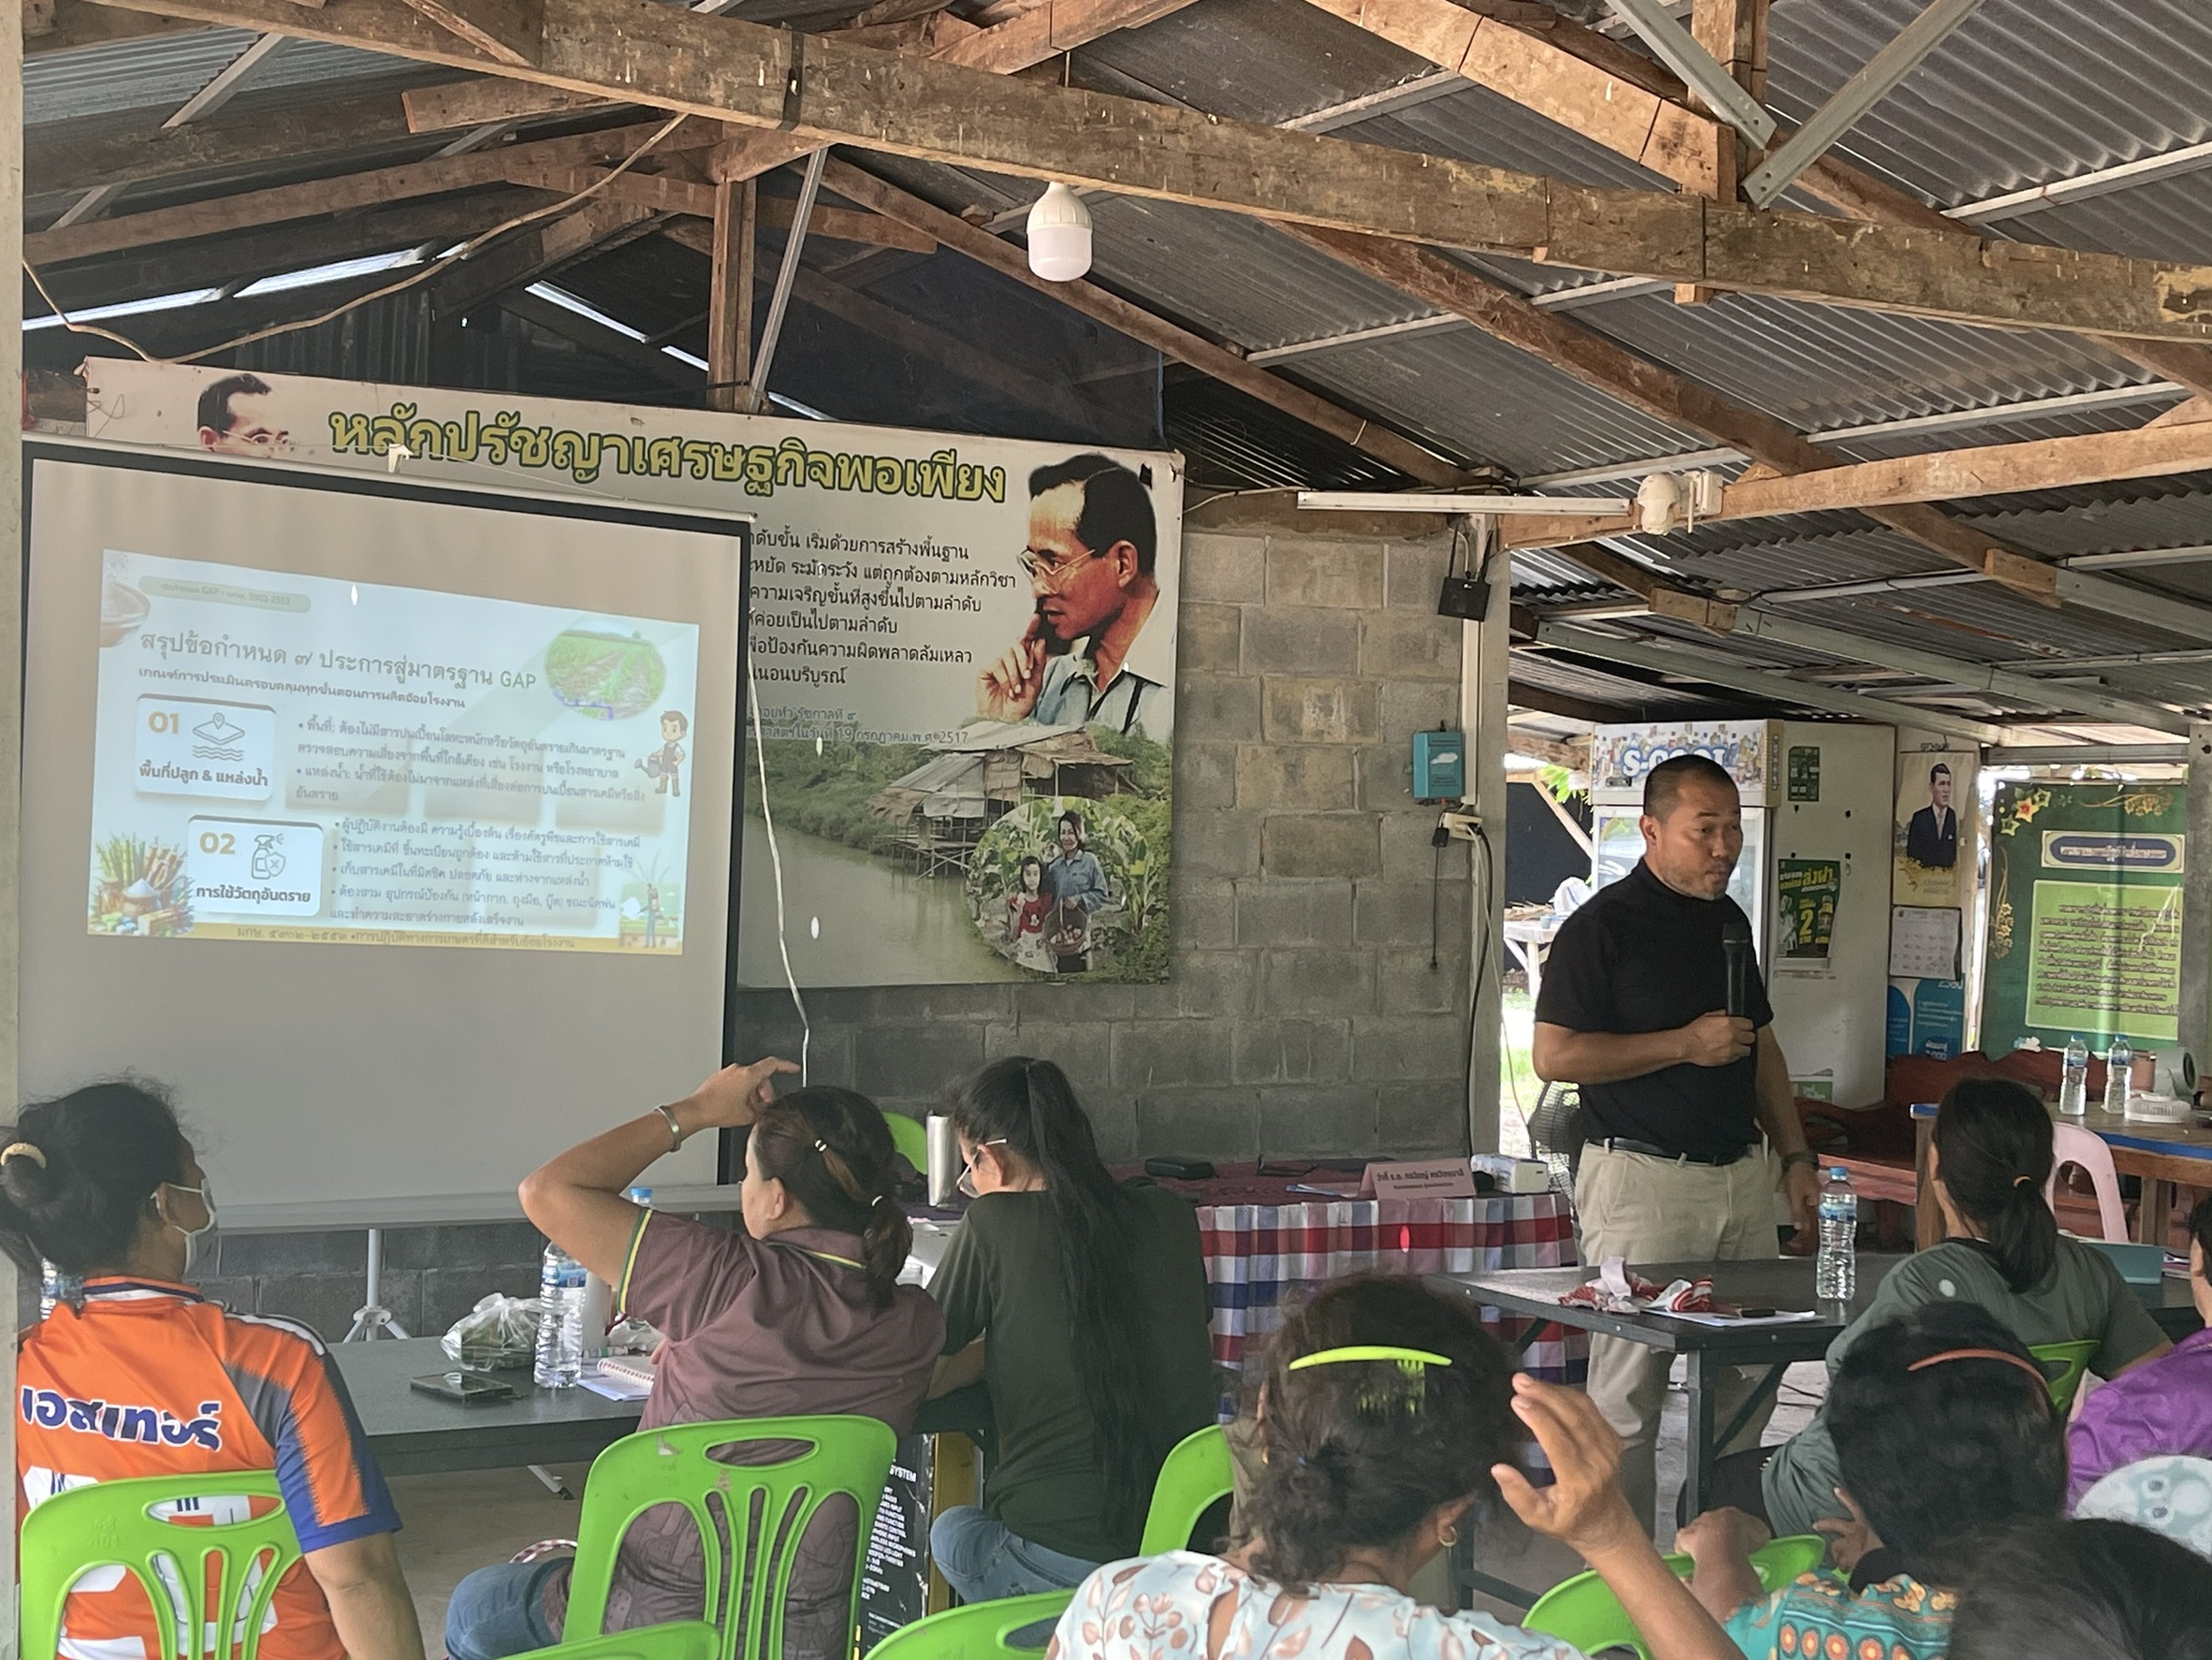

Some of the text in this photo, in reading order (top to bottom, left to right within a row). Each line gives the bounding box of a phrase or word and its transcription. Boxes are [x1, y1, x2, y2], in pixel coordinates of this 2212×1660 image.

[328, 402, 1008, 503] หลักปรัชญาเศรษฐกิจพอเพียง
[806, 528, 969, 563] เริ่มด้วยการสร้างพื้นฐาน
[864, 561, 1017, 590] แต่ถูกต้องตามหลักวิชา
[201, 586, 220, 596] GAP
[749, 582, 982, 613] ความเจริญขั้นที่สูงขึ้นไปตามลำดับ
[141, 629, 536, 690] สรุปข้อกำหนด ๗ ประการสู่มาตรฐาน GAP
[148, 709, 179, 735] 01
[837, 727, 852, 739] 19
[939, 731, 968, 745] 2517
[139, 758, 269, 787] พื้นที่ปลูก & แหล่งน้ำ
[508, 755, 544, 773] โรงงาน
[546, 760, 618, 779] หรือโรงพยาบาล
[296, 785, 339, 802] อันตราย
[198, 831, 236, 855] 02
[448, 867, 493, 881] ปลอดภัย
[196, 883, 312, 904] การใช้วัตถุอันตราย
[1799, 909, 1814, 936] 2
[22, 1385, 223, 1452] เอสเทอร์
[889, 1464, 917, 1483] SYSTEM
